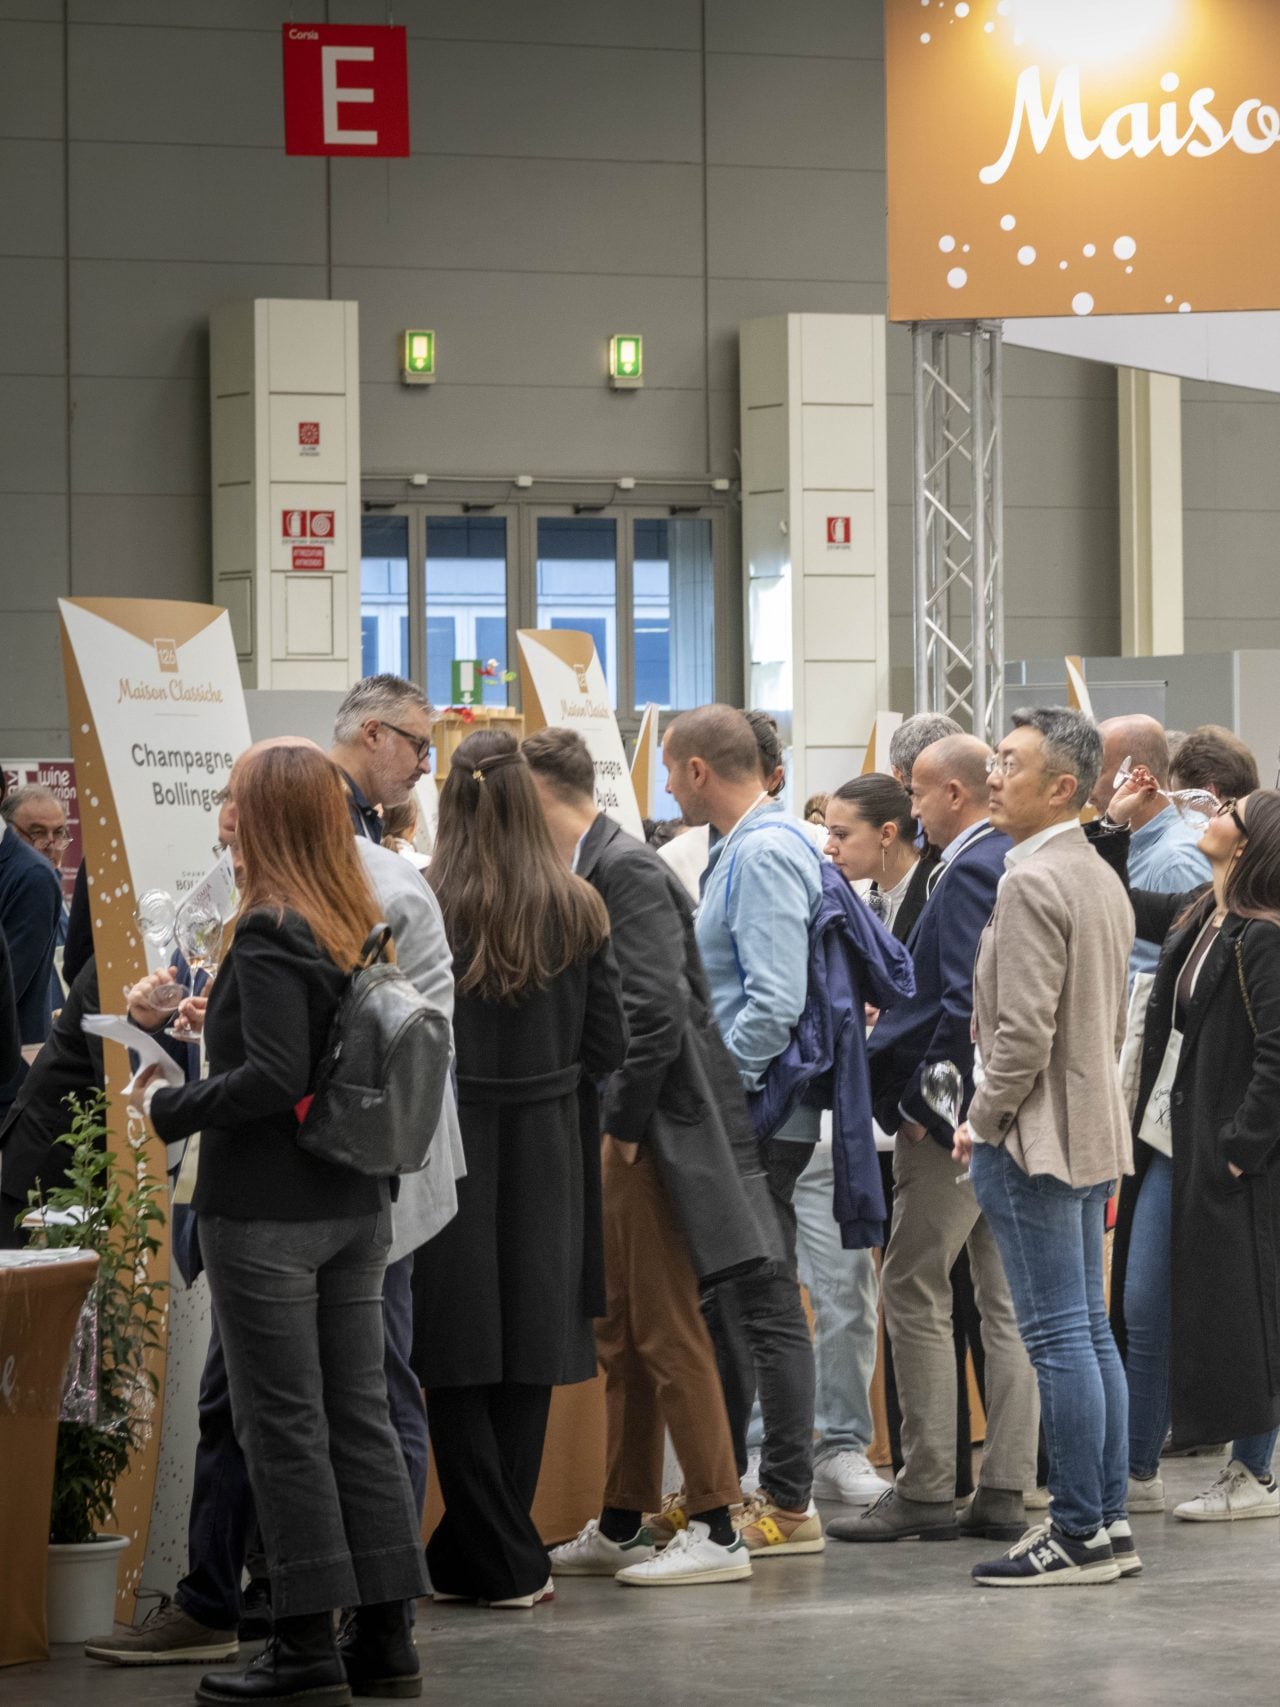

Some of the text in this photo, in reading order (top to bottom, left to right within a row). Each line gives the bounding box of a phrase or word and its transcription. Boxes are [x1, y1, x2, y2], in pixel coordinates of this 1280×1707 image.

[288, 28, 319, 41] Corsia
[321, 45, 378, 145] E
[118, 678, 223, 704] Maison Classiche
[131, 743, 234, 774] Champagne
[39, 766, 70, 787] wine
[152, 782, 222, 813] Bollinge
